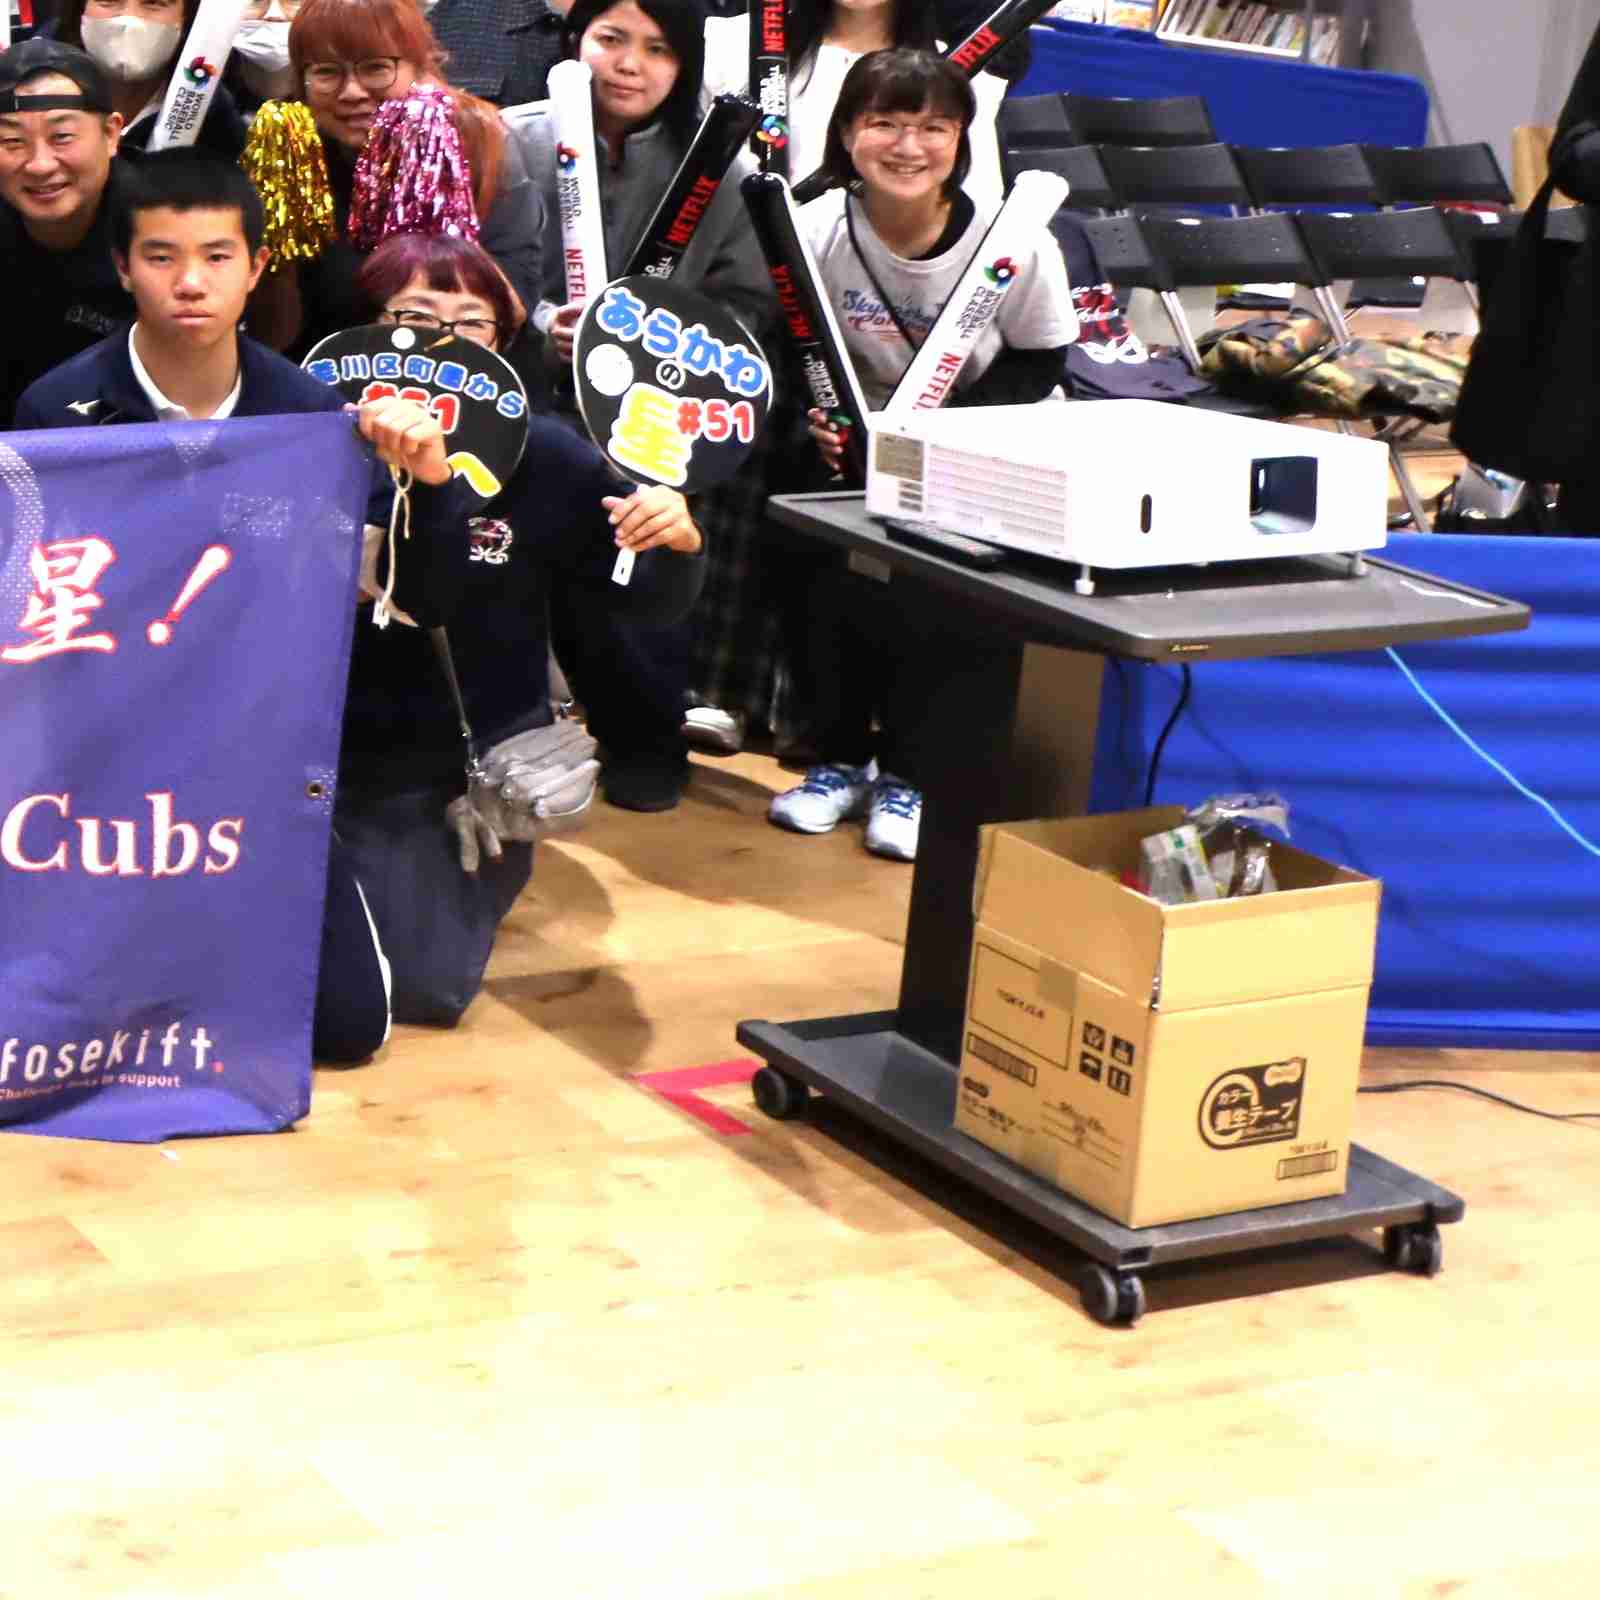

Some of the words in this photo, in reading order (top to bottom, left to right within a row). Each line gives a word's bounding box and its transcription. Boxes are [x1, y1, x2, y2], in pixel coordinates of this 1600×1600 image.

[164, 86, 186, 134] CLASSIC
[168, 91, 197, 141] BASEBALL
[191, 93, 206, 130] WORLD
[570, 177, 582, 218] WORLD
[666, 176, 720, 245] NETFLIX
[567, 249, 587, 301] NETFL
[769, 265, 812, 337] NETFLIX
[599, 288, 767, 396] あらかわ
[307, 354, 526, 418] 荒川区町屋から
[658, 362, 684, 387] の
[609, 384, 693, 486] 星
[677, 400, 755, 443] #51
[0, 791, 245, 879] Cubs
[118, 1073, 181, 1089] support
